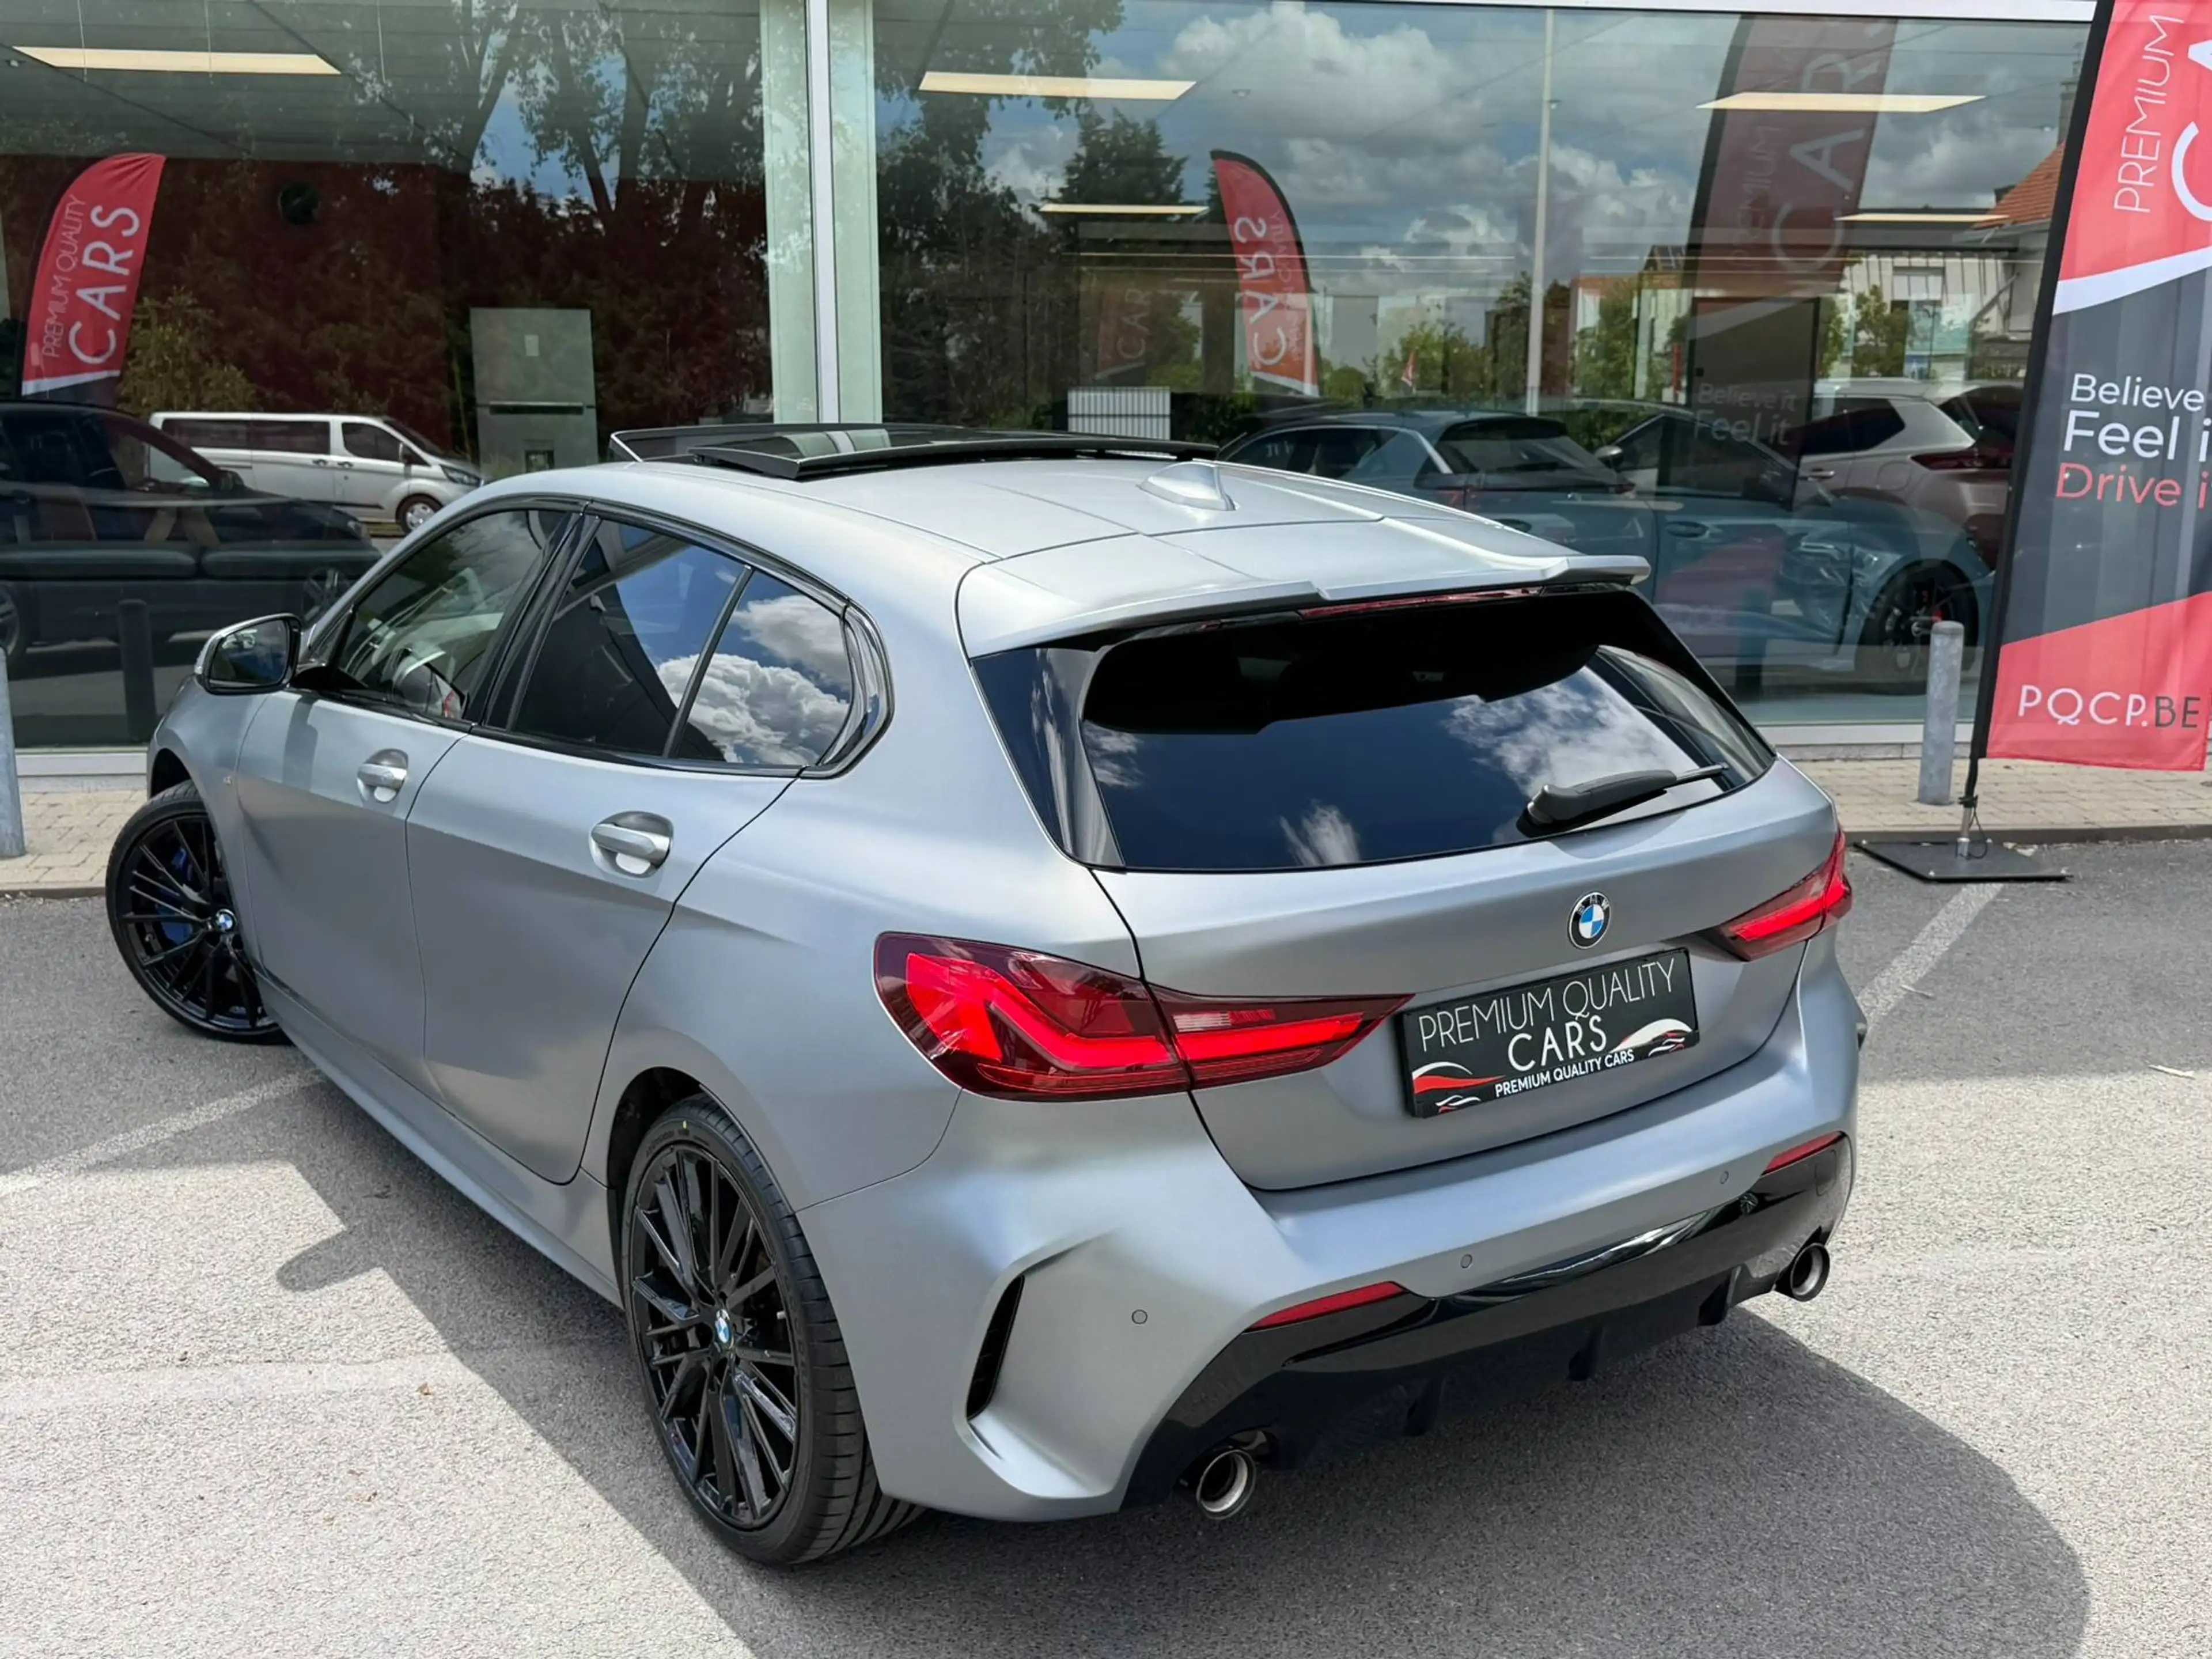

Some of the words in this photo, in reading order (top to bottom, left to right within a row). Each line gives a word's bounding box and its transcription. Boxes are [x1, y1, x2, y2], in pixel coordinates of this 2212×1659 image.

[2113, 14, 2184, 213] PREMIUM
[55, 193, 86, 272] QUALITY
[69, 204, 140, 365] CARS
[41, 274, 72, 358] PREMIUM
[2070, 373, 2205, 412] Believe
[2063, 410, 2180, 460] Feel
[2198, 418, 2212, 463] i
[2056, 462, 2182, 507] Drive
[2198, 471, 2212, 509] i
[2018, 684, 2201, 728] PQCP.BE
[1419, 987, 1555, 1052] PREMIUM
[1563, 957, 1675, 1020] QUALITY
[1508, 1015, 1607, 1071] CARS
[1495, 1070, 1551, 1097] PREMIUM
[1553, 1056, 1603, 1084] QUALITY
[1604, 1048, 1635, 1068] CARS
